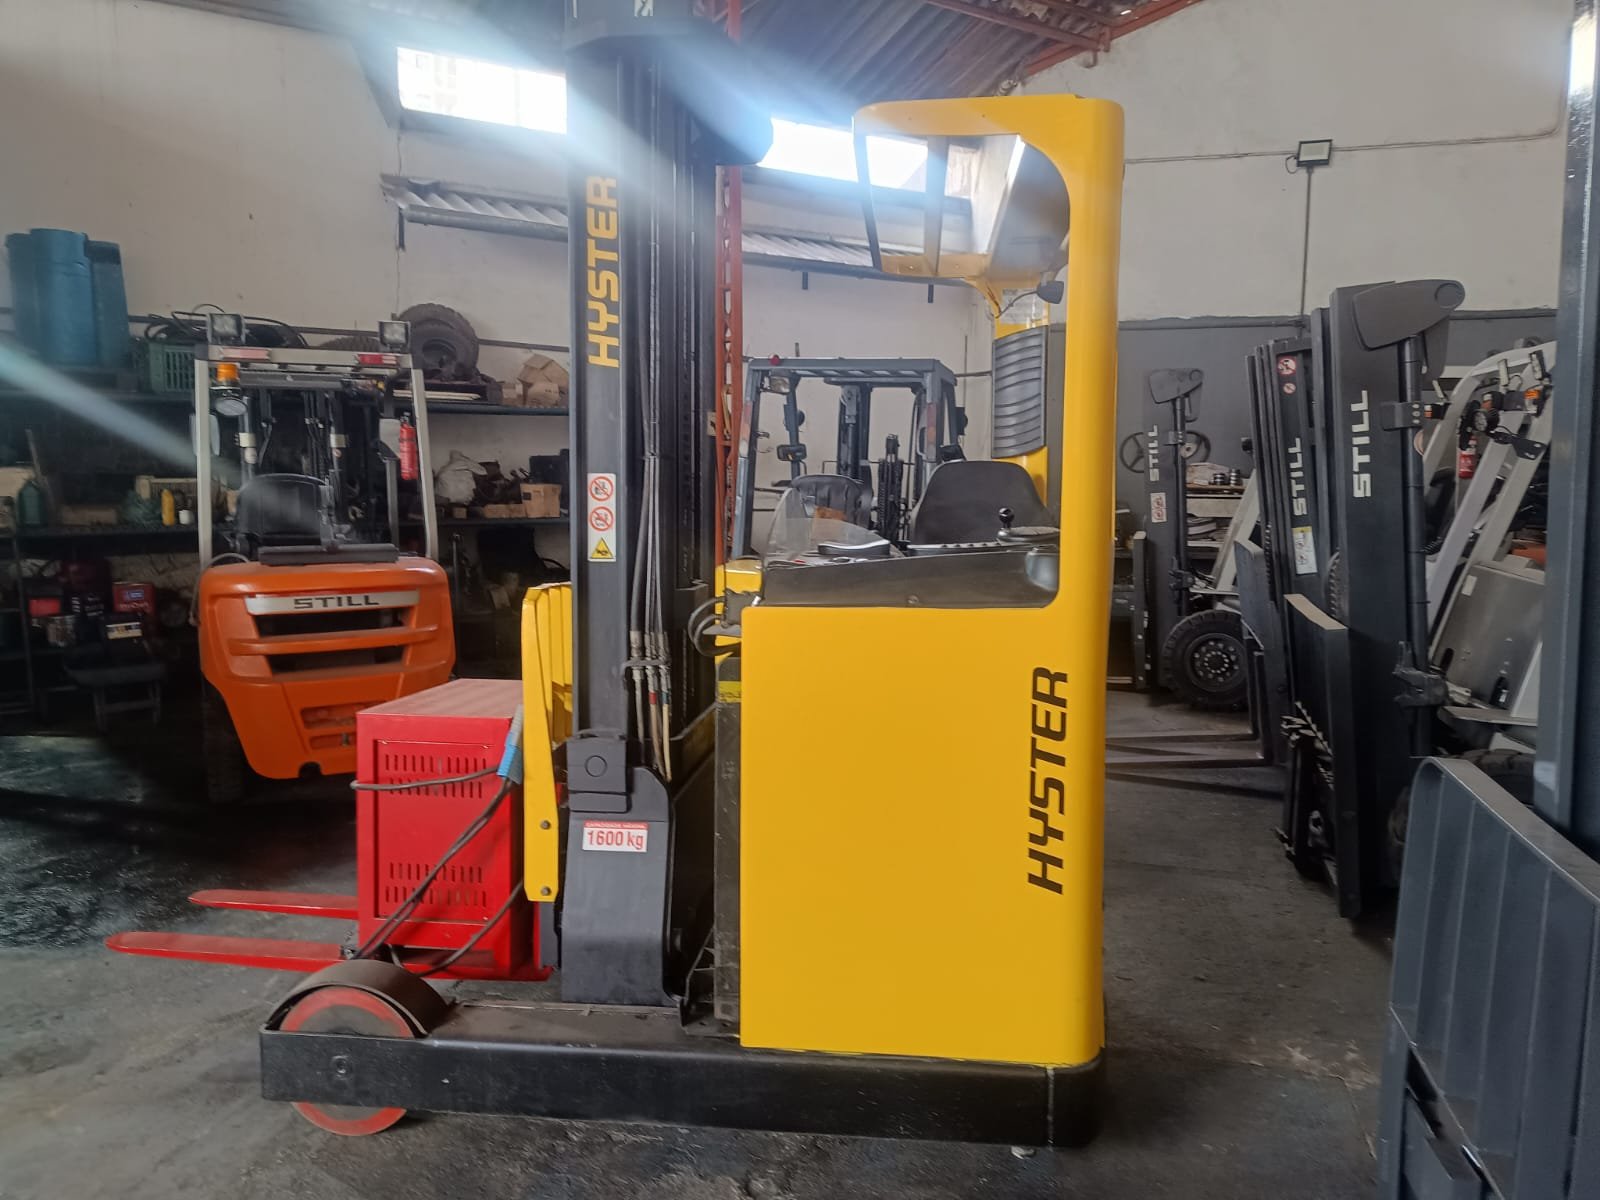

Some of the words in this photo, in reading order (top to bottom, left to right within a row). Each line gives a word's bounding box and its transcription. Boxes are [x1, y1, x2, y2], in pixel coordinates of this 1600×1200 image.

[586, 175, 620, 368] HYSTER
[1147, 424, 1160, 481] STILL
[1287, 437, 1307, 516] STILL
[1351, 389, 1371, 498] STILL
[293, 595, 380, 609] STILL
[1027, 666, 1068, 895] HYSTER
[587, 831, 624, 846] 1600
[627, 831, 644, 850] kg
